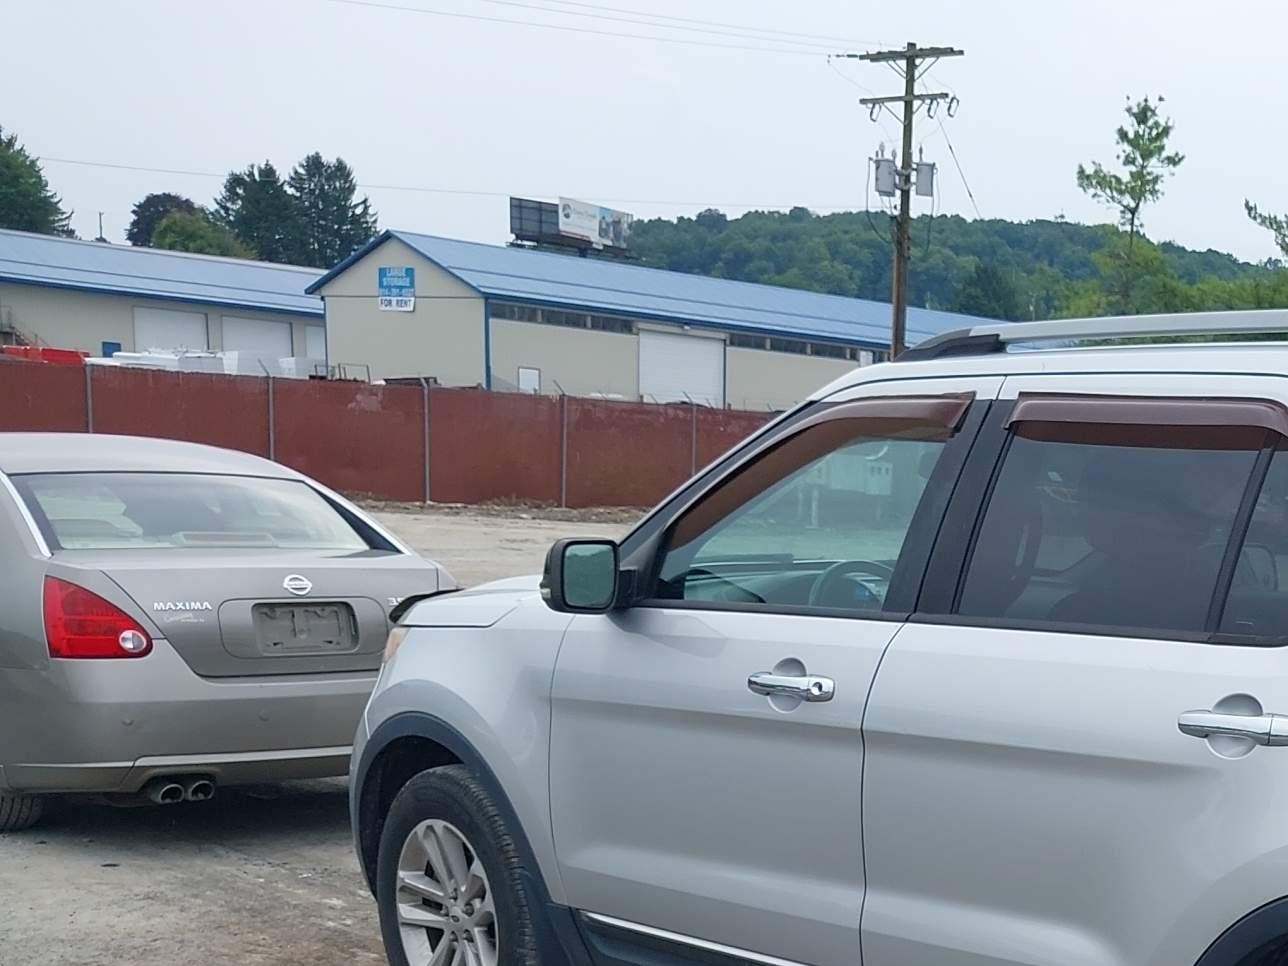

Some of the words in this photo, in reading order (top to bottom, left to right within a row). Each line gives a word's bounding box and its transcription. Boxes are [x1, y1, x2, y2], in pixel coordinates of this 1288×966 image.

[380, 298, 392, 308] FOR
[396, 298, 412, 309] RENT
[153, 601, 213, 612] MAXIMA
